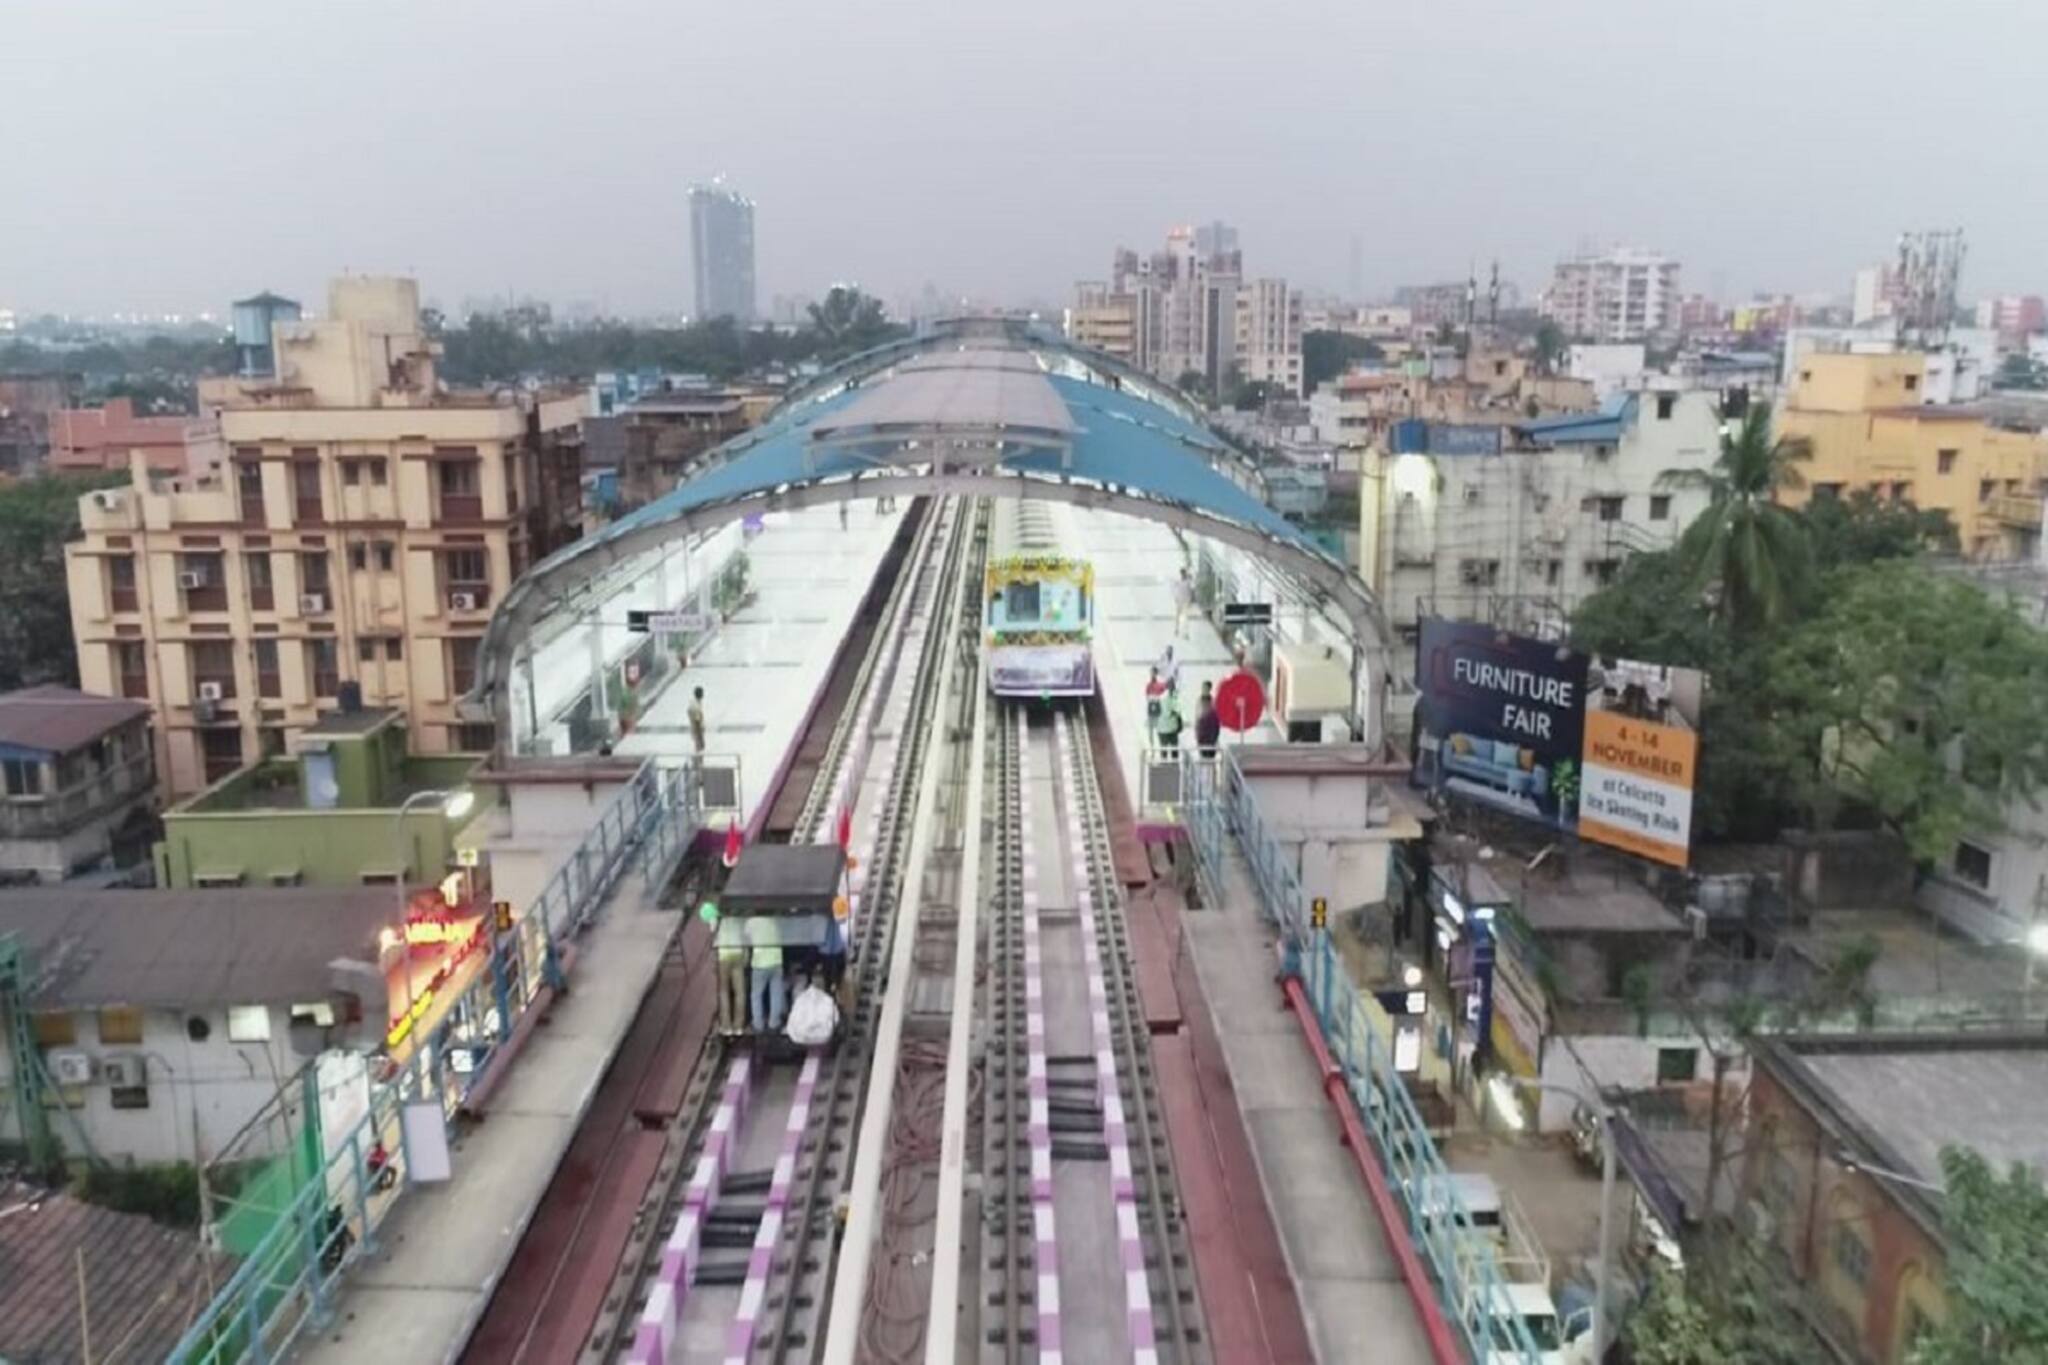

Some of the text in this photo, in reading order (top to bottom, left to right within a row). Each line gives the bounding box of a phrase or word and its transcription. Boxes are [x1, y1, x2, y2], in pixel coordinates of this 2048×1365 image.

[1453, 657, 1574, 708] FURNITURE
[1503, 704, 1552, 739] FAIR
[1618, 726, 1627, 741] 4
[1641, 730, 1659, 749] 14
[1593, 741, 1683, 777] NOVEMBER
[1618, 781, 1666, 808] Calcutta
[1587, 794, 1680, 835] Ice Skating Rink
